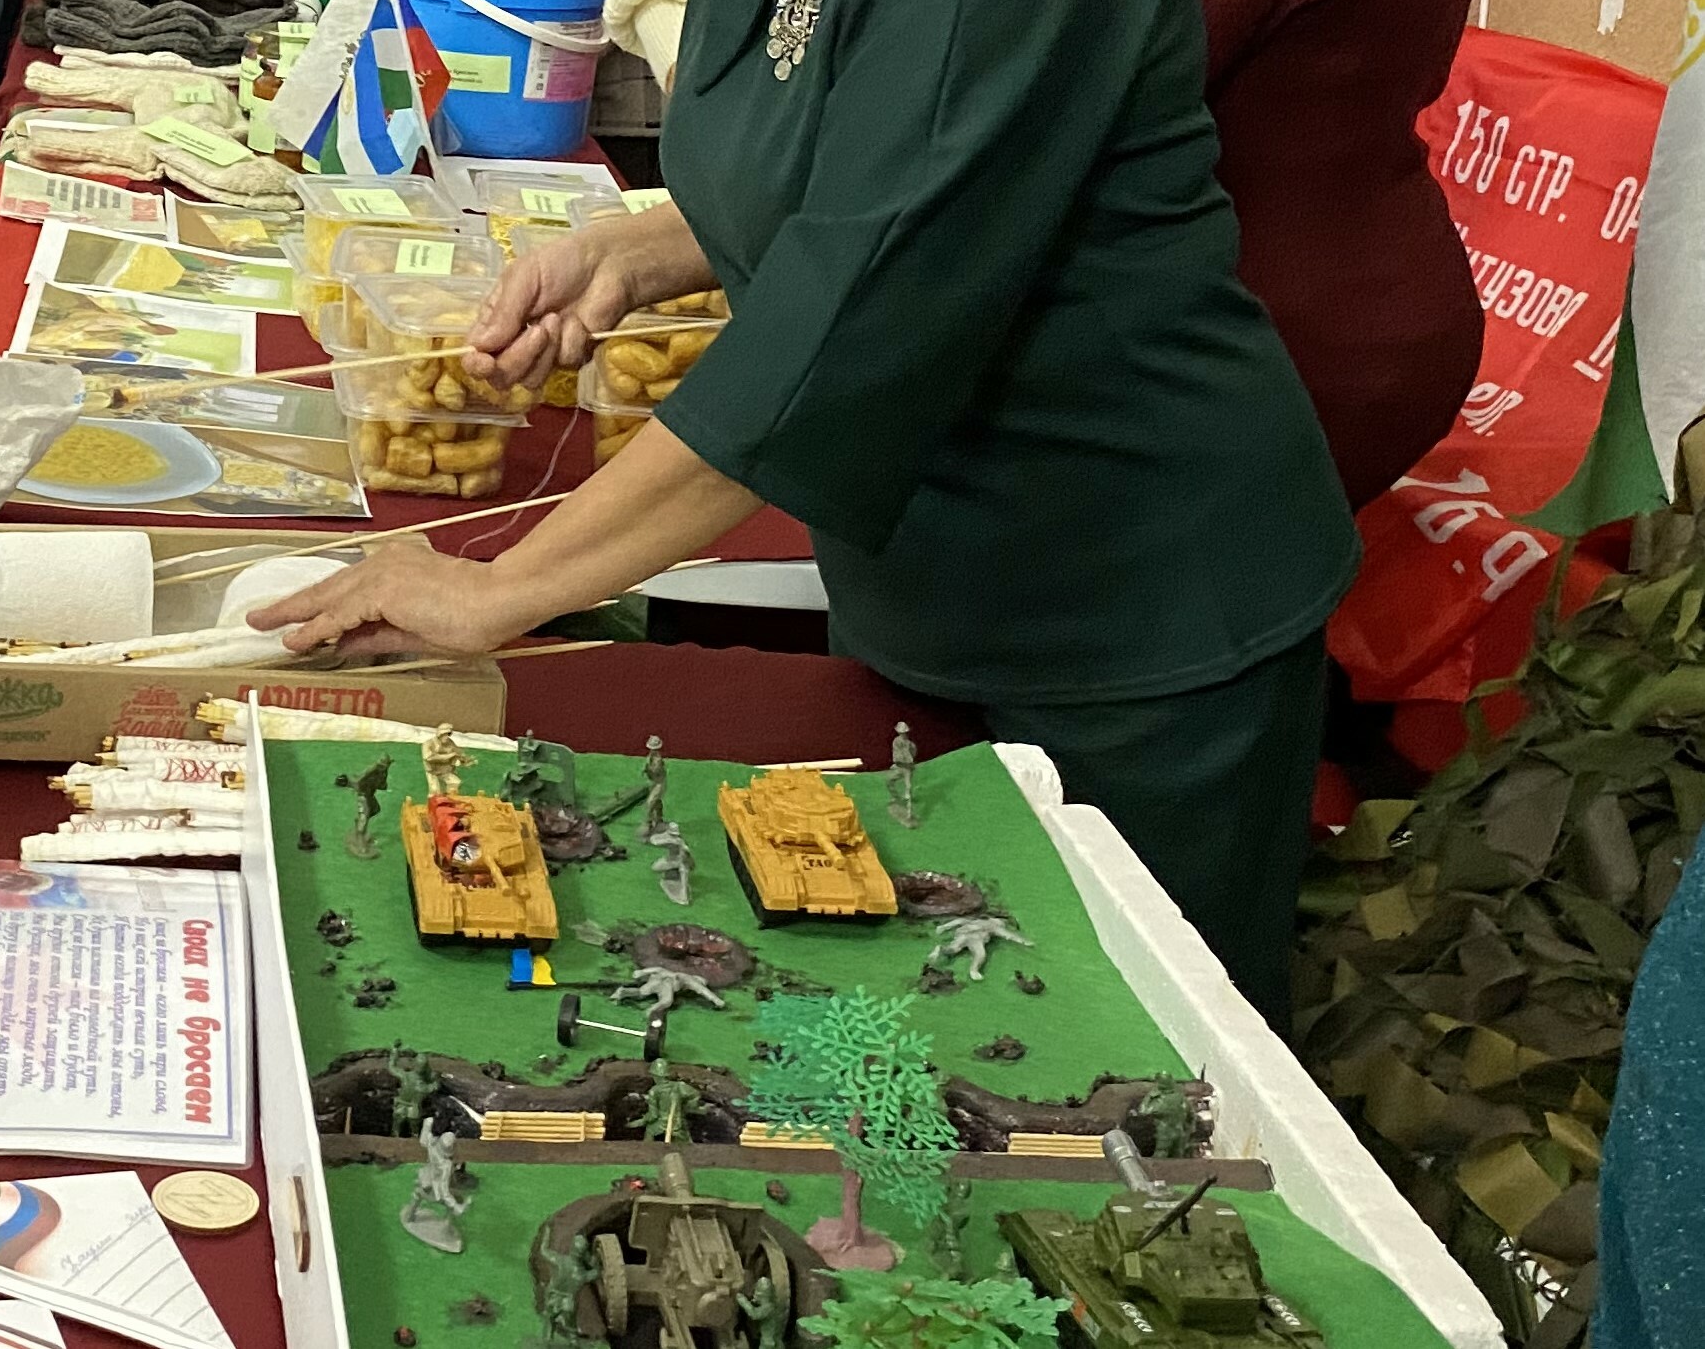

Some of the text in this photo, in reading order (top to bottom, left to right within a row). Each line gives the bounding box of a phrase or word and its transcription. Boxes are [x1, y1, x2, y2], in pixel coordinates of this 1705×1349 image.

[1440, 98, 1510, 196] 150
[1505, 143, 1575, 223] СТР.
[177, 919, 221, 1124] Своих не бросаем
